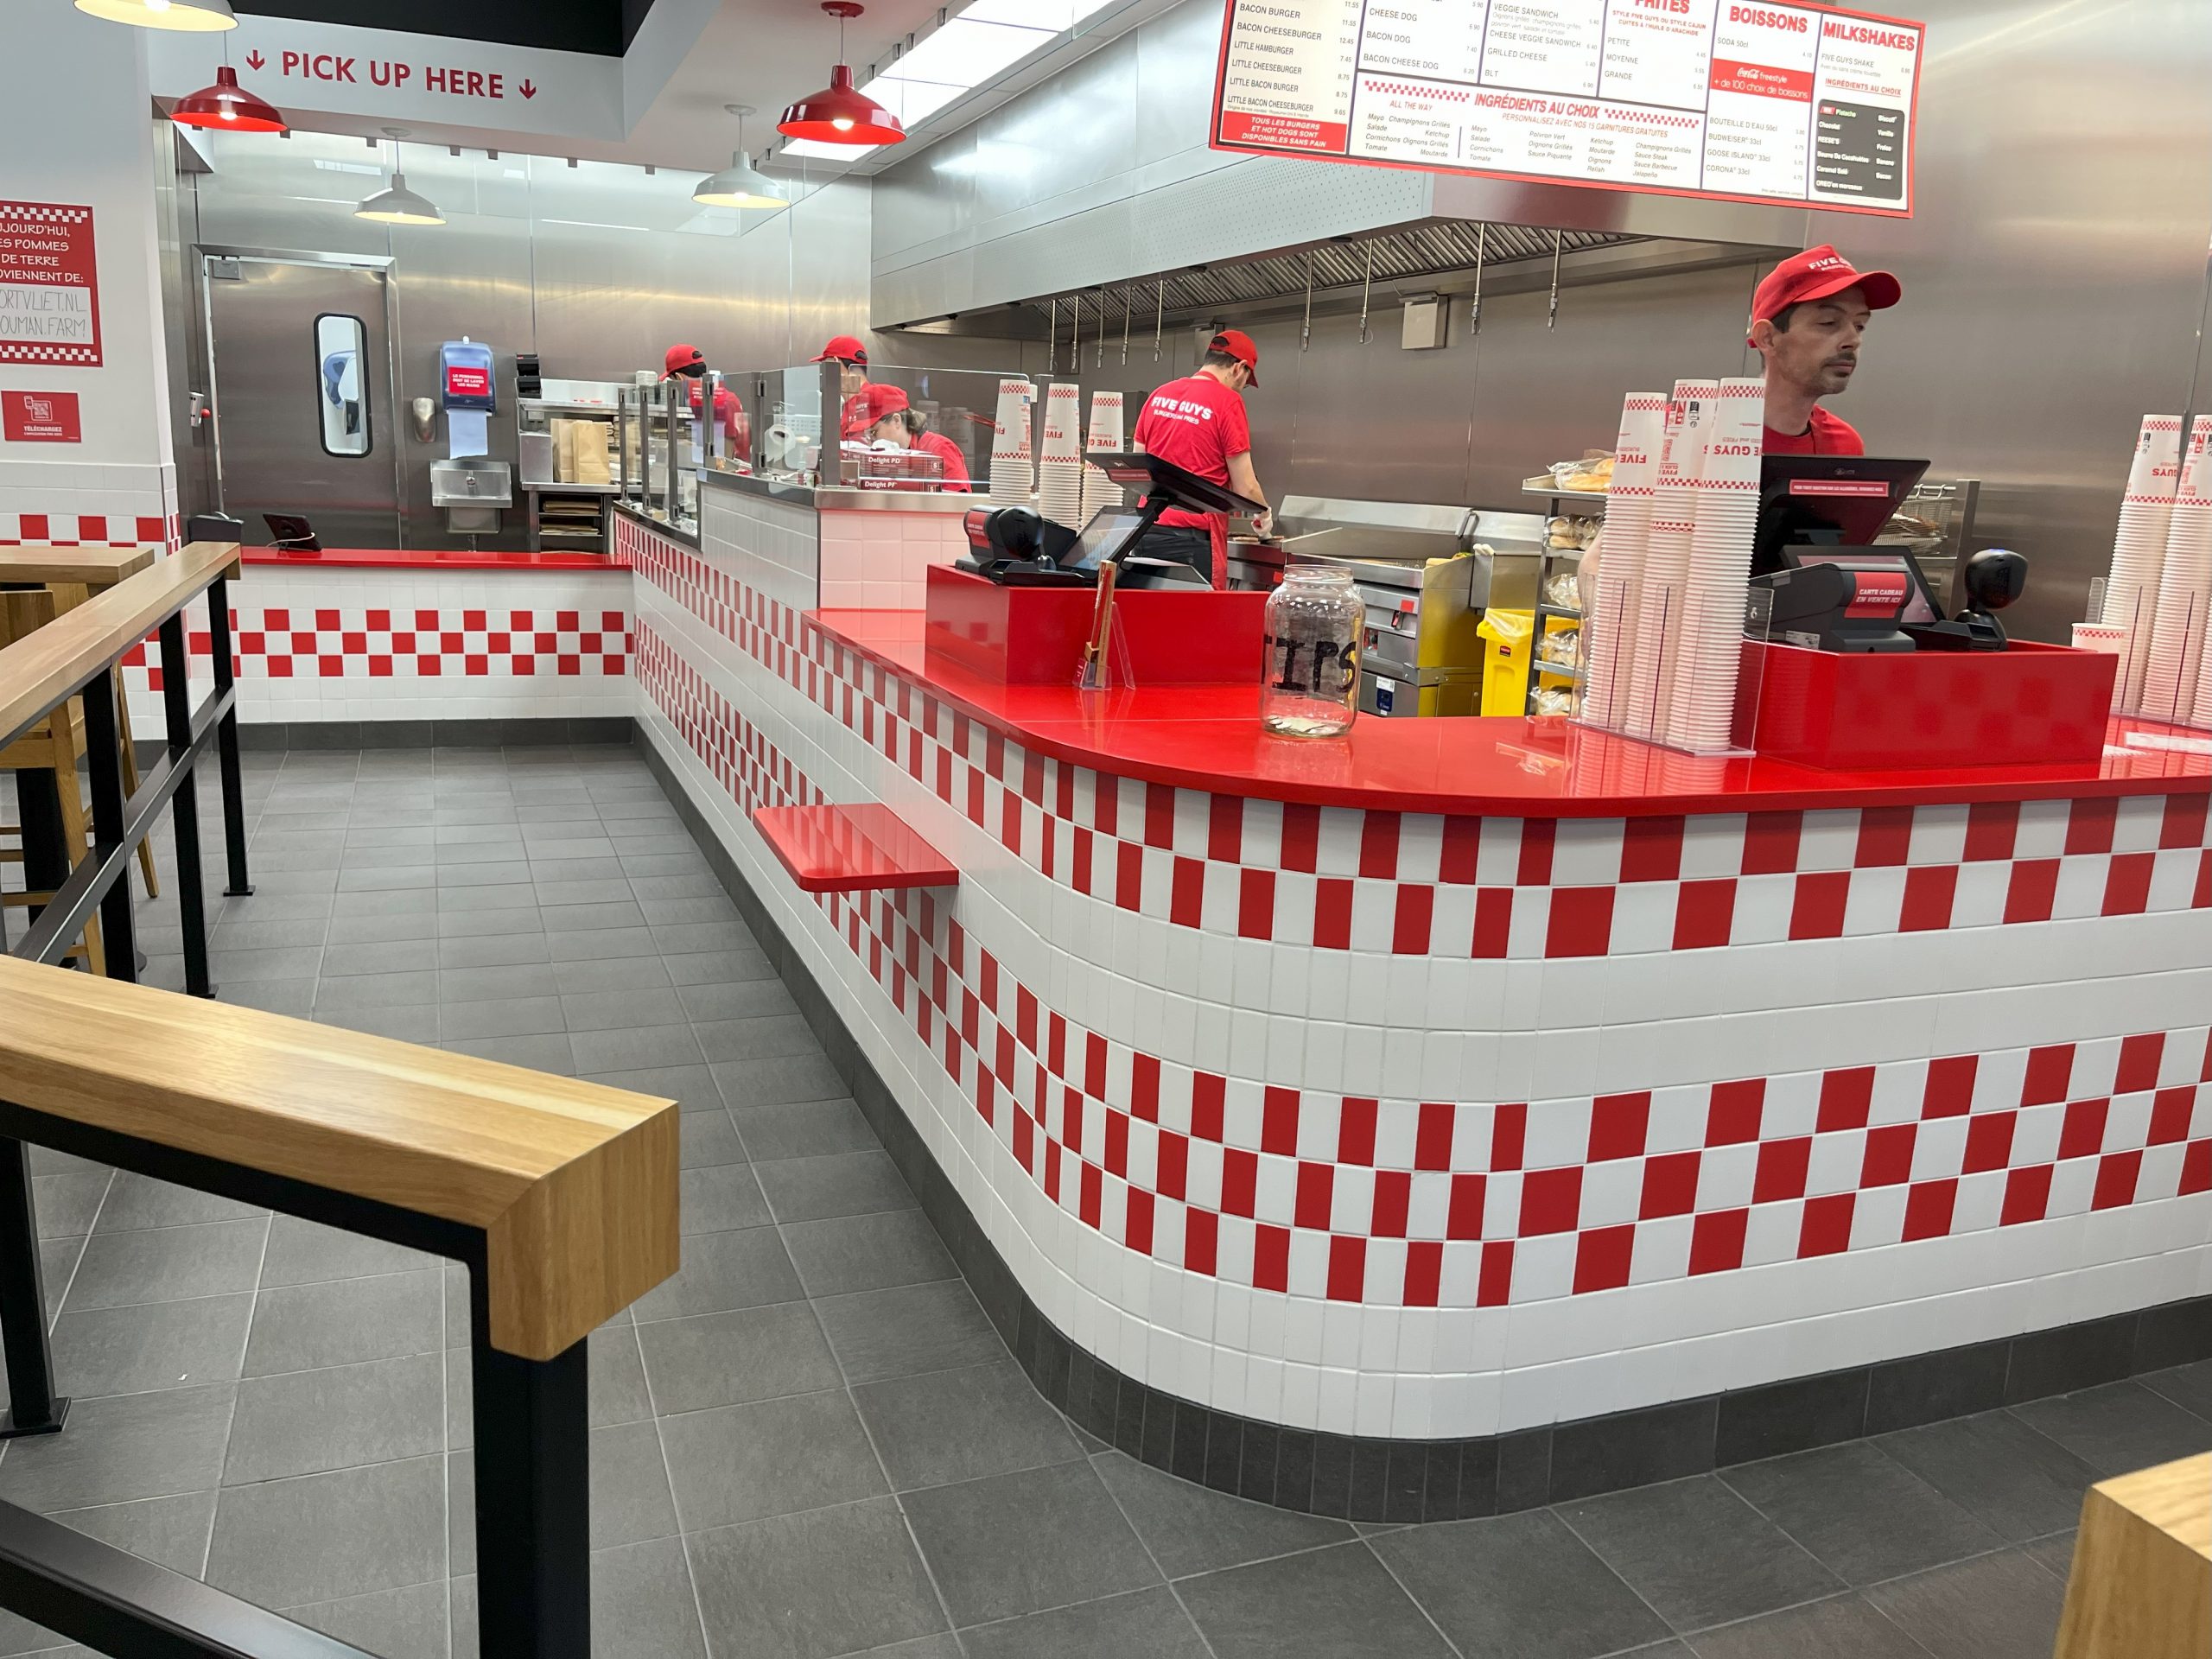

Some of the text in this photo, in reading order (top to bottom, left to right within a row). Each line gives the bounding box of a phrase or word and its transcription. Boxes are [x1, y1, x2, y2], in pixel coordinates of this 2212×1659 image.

[1240, 3, 1300, 18] BACON BURGER
[1370, 8, 1398, 19] CHEESE
[1494, 3, 1558, 18] VEGGIE SANDWICH
[1729, 6, 1808, 33] BOISSONS
[1237, 22, 1321, 41] BACON CHEESEBURGER
[1366, 31, 1392, 41] BACON
[1823, 22, 1915, 51] MILKSHAKES
[1490, 29, 1580, 48] CHEESE VEGGIE SANDWICH
[1608, 37, 1630, 46] PETITE
[1235, 41, 1294, 55] LITTLE HAMBURGER
[1363, 54, 1389, 63] BACON
[1392, 57, 1421, 67] CHEESE
[1488, 48, 1548, 61] GRILLED CHEESE
[1606, 54, 1638, 64] MOYENNE
[1232, 59, 1301, 74] LITTLE CHEESEBURGER
[1836, 55, 1853, 65] GUYS
[1854, 59, 1874, 67] SHAKE
[283, 51, 503, 99] PICK UP HERE
[1605, 71, 1632, 79] GRANDE
[1759, 72, 1787, 83] freestyle
[1230, 77, 1298, 92] LITTLE BACON BURGER
[1732, 79, 1745, 90] 100
[1747, 82, 1764, 92] choix
[1767, 85, 1777, 94] de
[1778, 87, 1808, 99] boissons
[1825, 78, 1868, 90] INGRÉDIENTS
[1881, 86, 1901, 95] CHOIX
[1248, 99, 1268, 107] BACON
[1268, 100, 1313, 111] CHEESEBURGER
[1474, 93, 1599, 118] INGRÉDIENTS AU CHOIX
[1287, 121, 1320, 130] BURGERS
[1389, 116, 1429, 126] Champignons
[1503, 113, 1554, 124] PERSONNALISEZ
[1596, 123, 1634, 133] GARNITURES
[1636, 128, 1668, 137] GRATUITES
[1710, 118, 1744, 127] BOUTEILLE
[1242, 133, 1287, 143] DISPONIBLES
[1366, 133, 1401, 143] Cornichons
[1403, 137, 1427, 146] Oignons
[1425, 130, 1449, 138] Ketchup
[1636, 143, 1672, 152] Champignons
[1707, 149, 1729, 157] GOOSE
[15, 239, 68, 251] POMMES
[2, 254, 59, 266] DE TERRE
[1808, 257, 1838, 269] FIVE
[65, 273, 83, 283] DE:
[1151, 397, 1211, 420] FIVE GUYS
[1714, 444, 1751, 454] GUYS
[1620, 454, 1646, 463] FIVE
